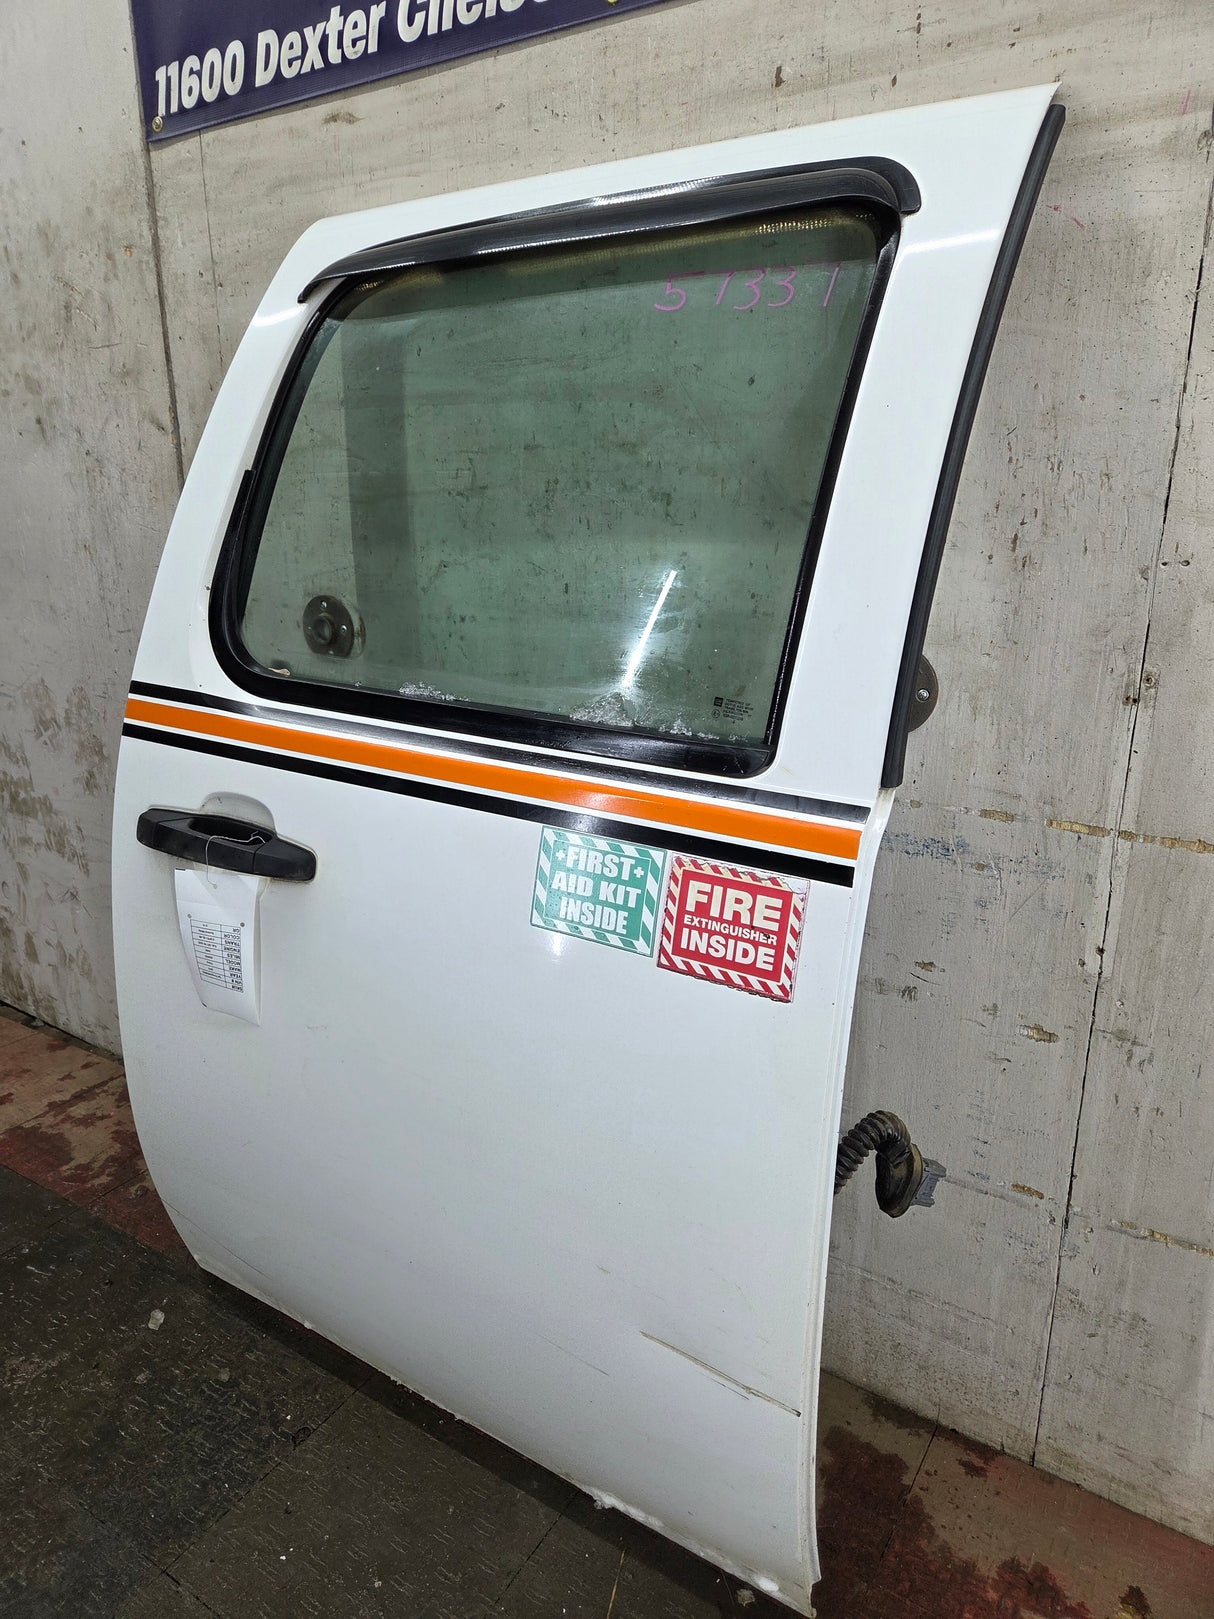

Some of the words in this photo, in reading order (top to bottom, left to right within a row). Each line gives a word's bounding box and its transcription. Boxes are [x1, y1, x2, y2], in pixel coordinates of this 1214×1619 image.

[155, 40, 245, 116] 11600
[255, 0, 386, 87] Dexter
[566, 846, 636, 881] FIRST
[551, 870, 594, 897] AID
[598, 881, 642, 908] KIT
[685, 880, 783, 931] FIRE
[559, 896, 629, 935] INSIDE
[683, 914, 778, 946] EXTINGUISHER
[680, 928, 776, 971] INSIDE
